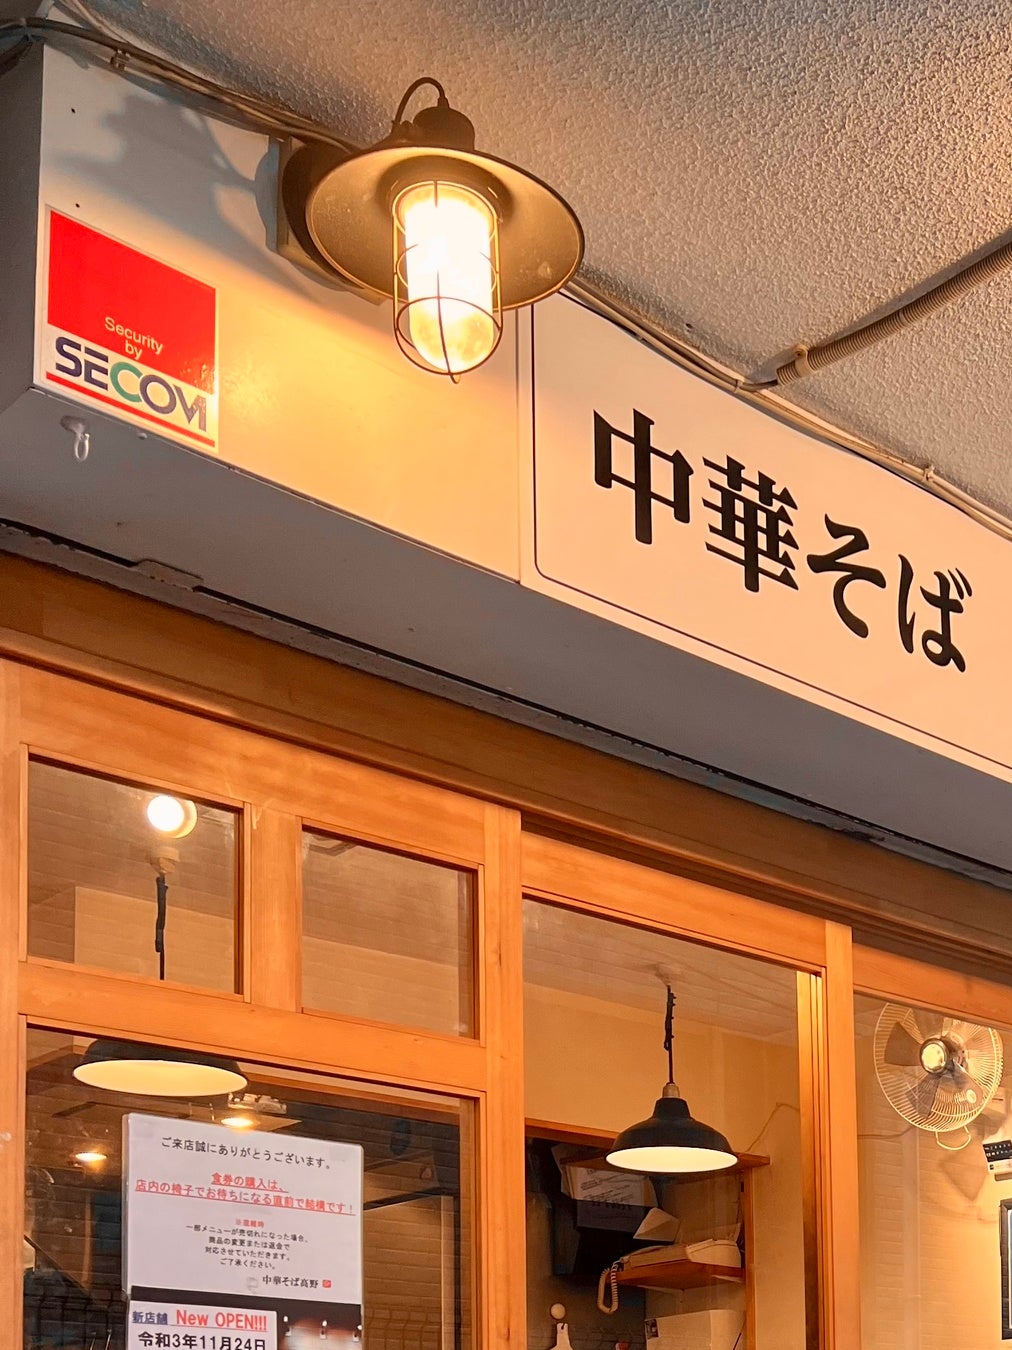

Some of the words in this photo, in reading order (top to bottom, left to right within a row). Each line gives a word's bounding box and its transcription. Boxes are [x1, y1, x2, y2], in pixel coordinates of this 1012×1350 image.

[104, 316, 163, 356] Security
[125, 339, 143, 361] by
[55, 336, 207, 433] SECOM
[593, 408, 973, 673] 中華そば
[161, 1136, 331, 1170] ご来店誠にありがとうございます。
[132, 1310, 168, 1325] 新店舗
[176, 1309, 208, 1326] New
[215, 1311, 267, 1331] OPEN!!!
